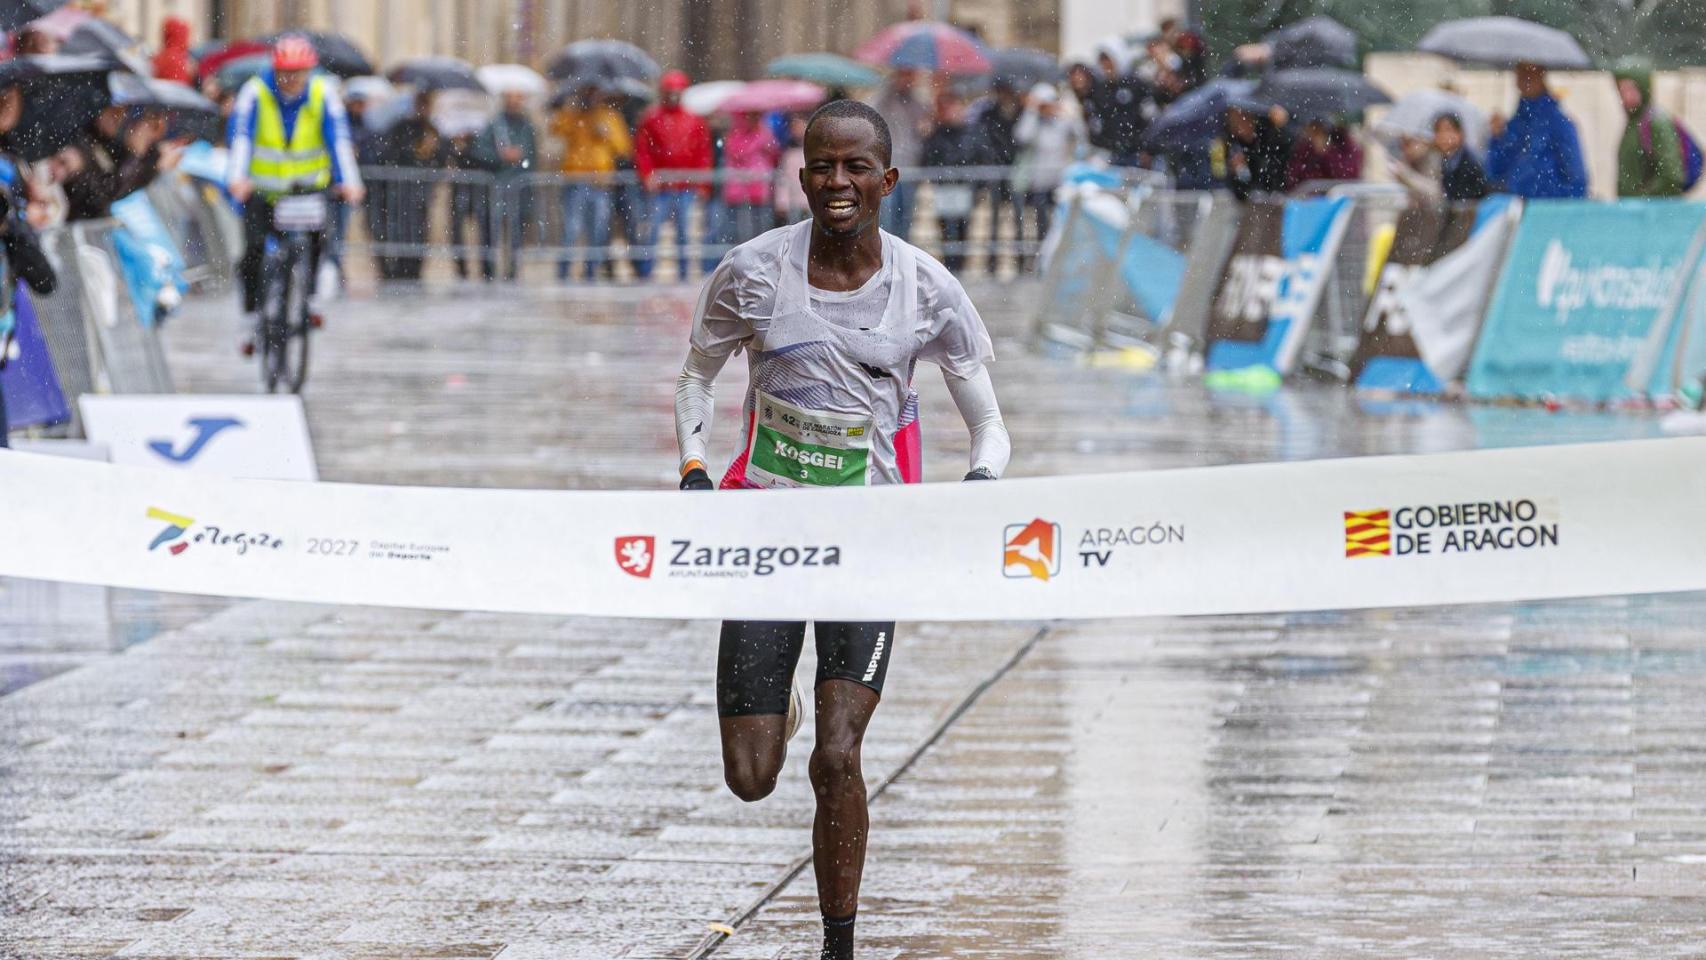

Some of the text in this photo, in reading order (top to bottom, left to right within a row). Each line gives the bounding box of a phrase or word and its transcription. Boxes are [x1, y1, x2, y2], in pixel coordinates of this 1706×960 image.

[775, 440, 844, 470] KOSGEI
[800, 469, 808, 479] 3
[1395, 499, 1536, 529] GOBIERNO
[307, 538, 359, 556] 2027
[1079, 521, 1185, 548] ARAGÓN
[1396, 524, 1558, 555] DE ARAGON
[669, 540, 841, 576] Zaragoza
[1079, 550, 1113, 567] TV
[668, 570, 749, 578] AYUNTAMIENTO
[862, 631, 886, 681] KIPRUN
